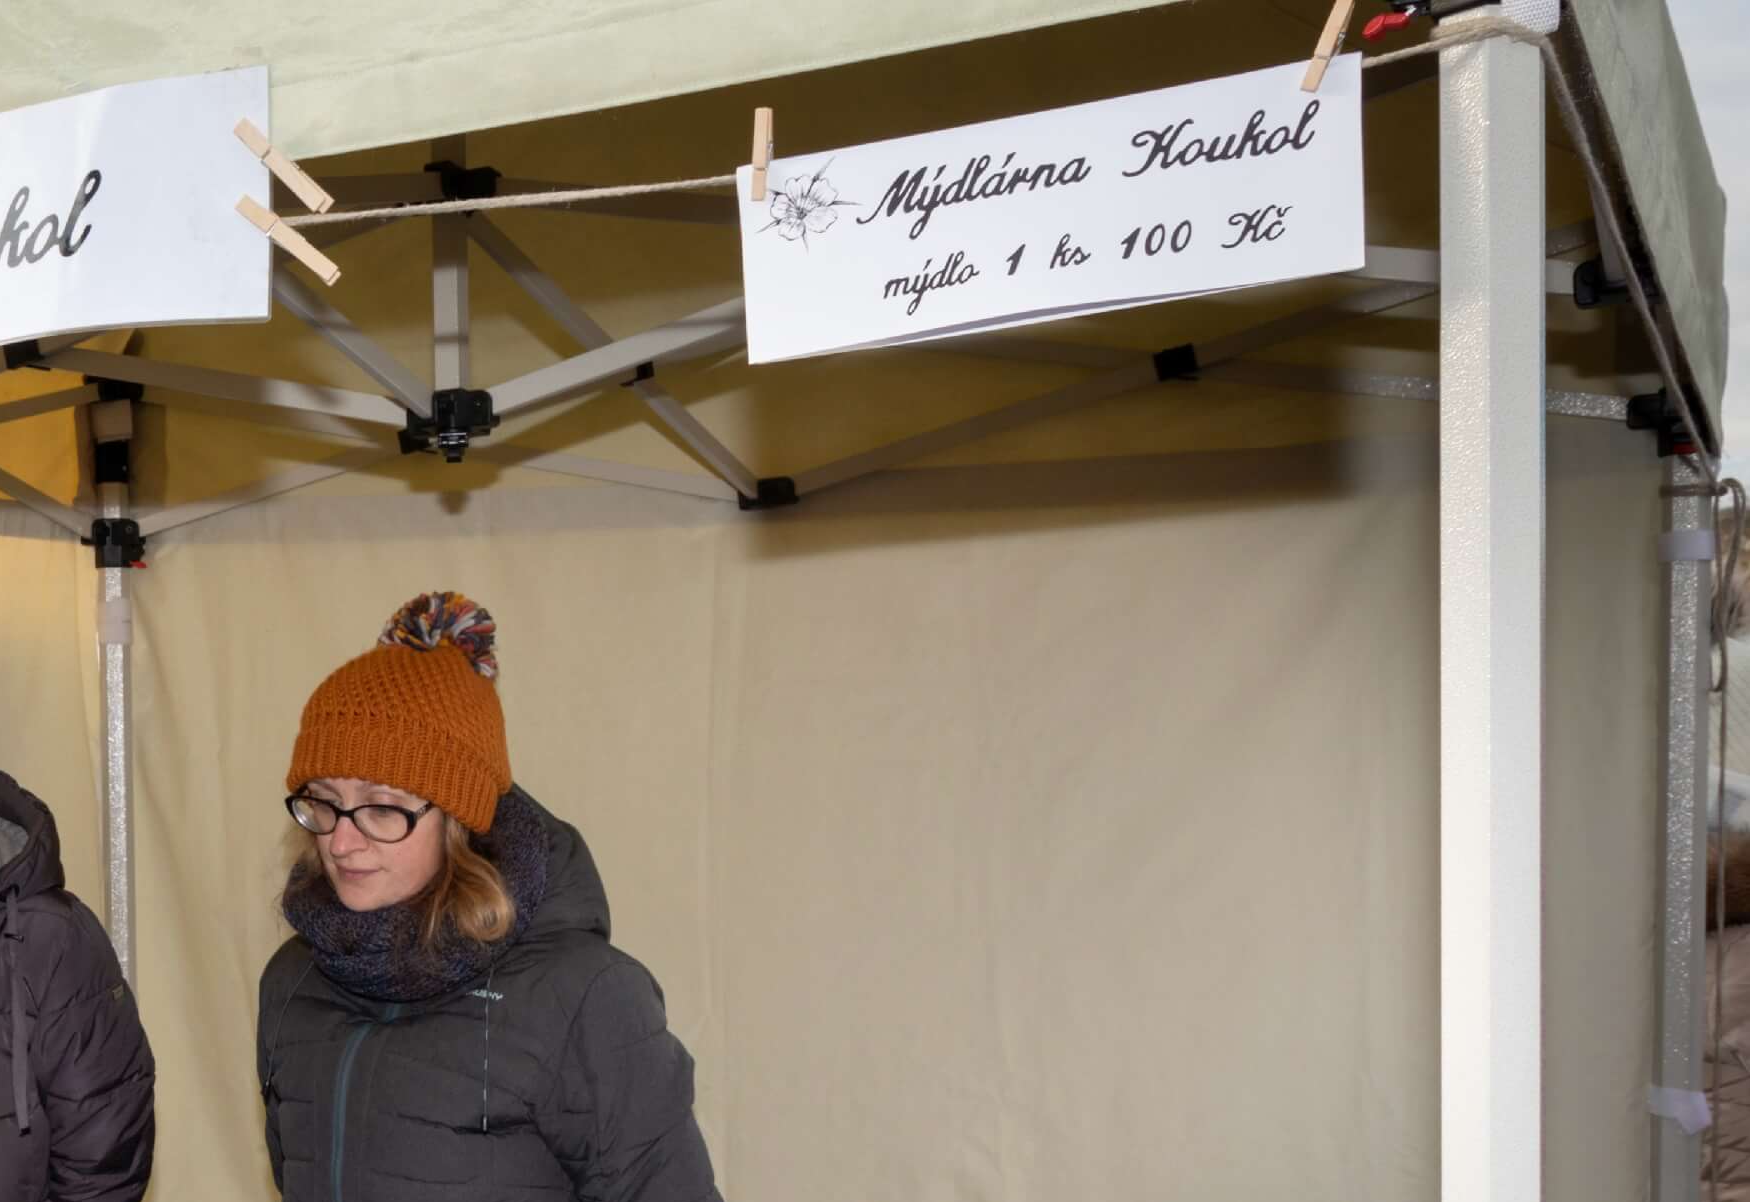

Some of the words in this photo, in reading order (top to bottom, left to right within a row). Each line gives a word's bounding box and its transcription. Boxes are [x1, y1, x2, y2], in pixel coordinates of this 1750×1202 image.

[856, 151, 1091, 239] Mýdlárna
[1122, 100, 1319, 177] Koukol
[883, 252, 979, 315] mýdlo
[1005, 244, 1027, 276] 1
[1050, 233, 1091, 269] ks
[1121, 219, 1192, 261] 100
[1221, 204, 1292, 251] Kč
